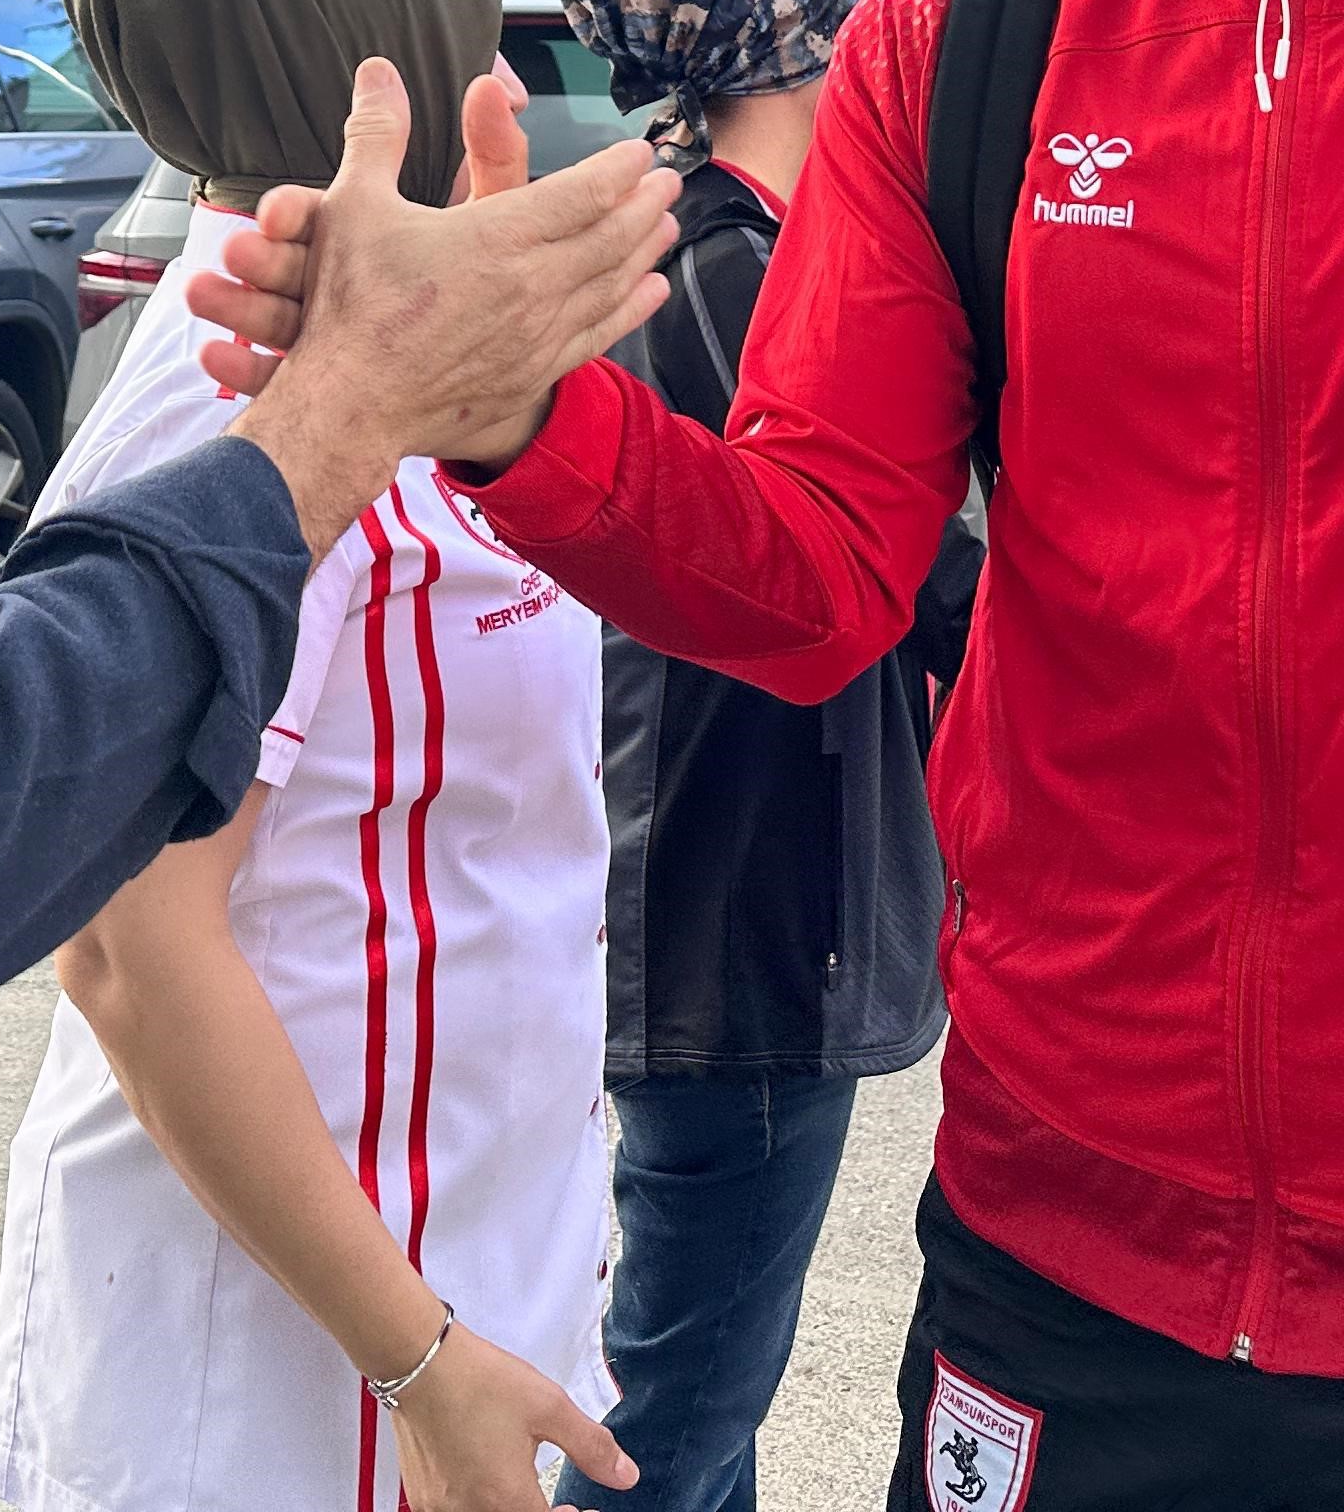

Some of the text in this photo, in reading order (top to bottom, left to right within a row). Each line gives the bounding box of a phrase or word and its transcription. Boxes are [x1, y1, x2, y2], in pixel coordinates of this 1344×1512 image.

[1033, 192, 1135, 229] hummel
[476, 595, 543, 635] MERYEM
[943, 1386, 1016, 1441] SAMSUNSPOR
